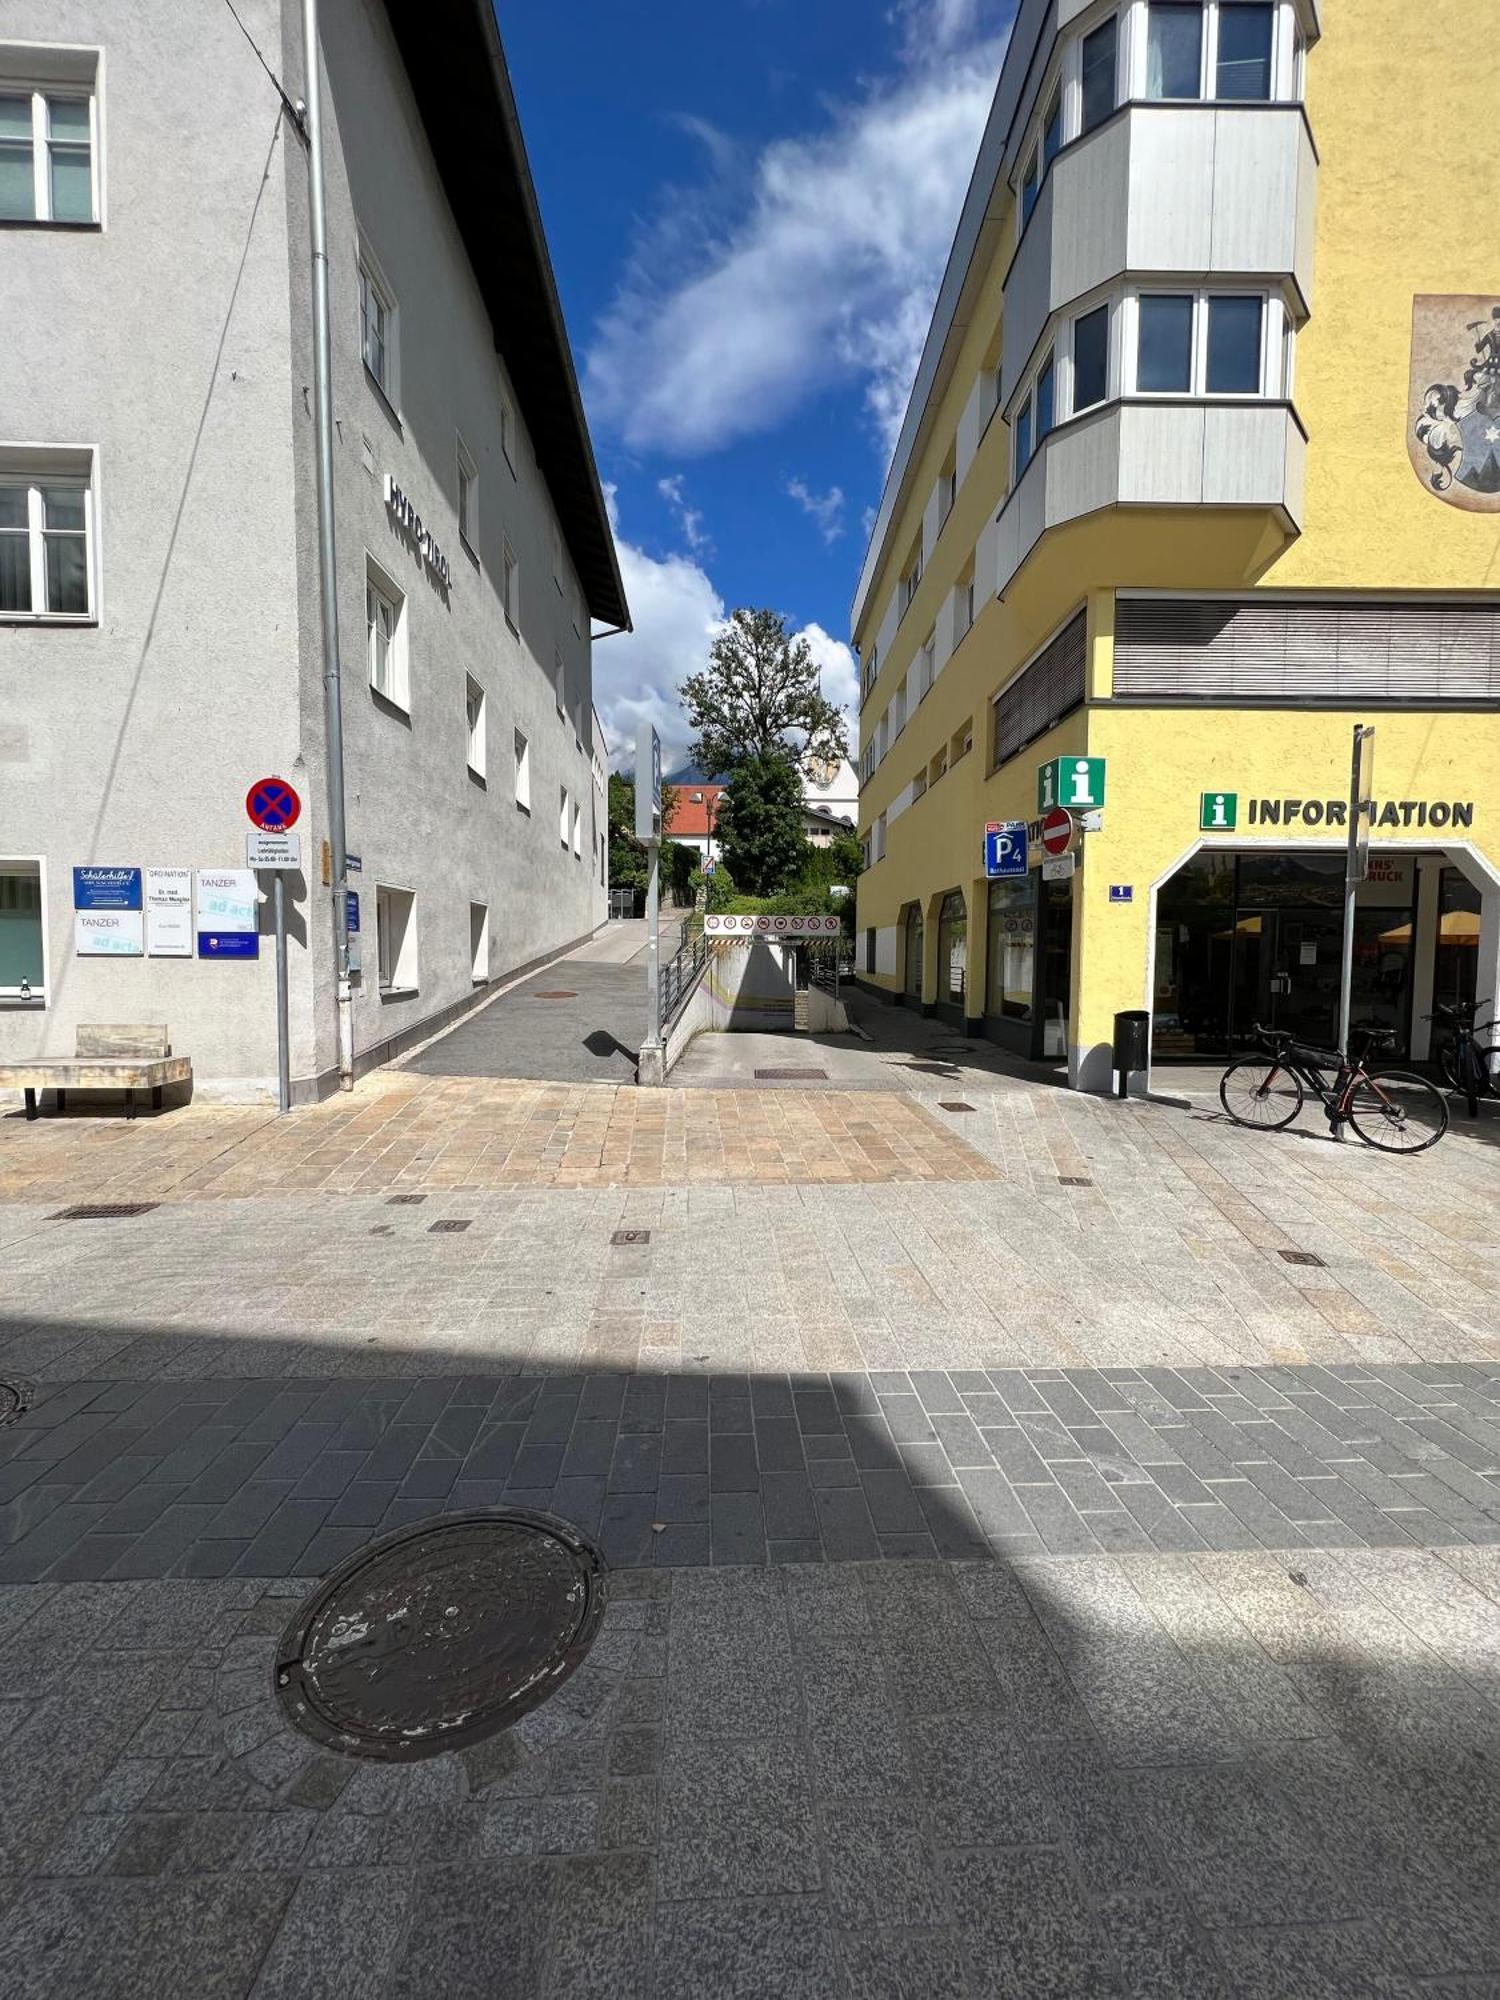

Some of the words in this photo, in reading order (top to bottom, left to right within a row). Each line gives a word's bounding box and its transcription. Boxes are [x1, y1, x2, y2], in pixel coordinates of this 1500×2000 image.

[996, 838, 1012, 863] P
[1013, 848, 1022, 862] 4
[201, 879, 236, 887] TANZER
[1118, 886, 1123, 895] 1
[81, 918, 120, 927] TANZER
